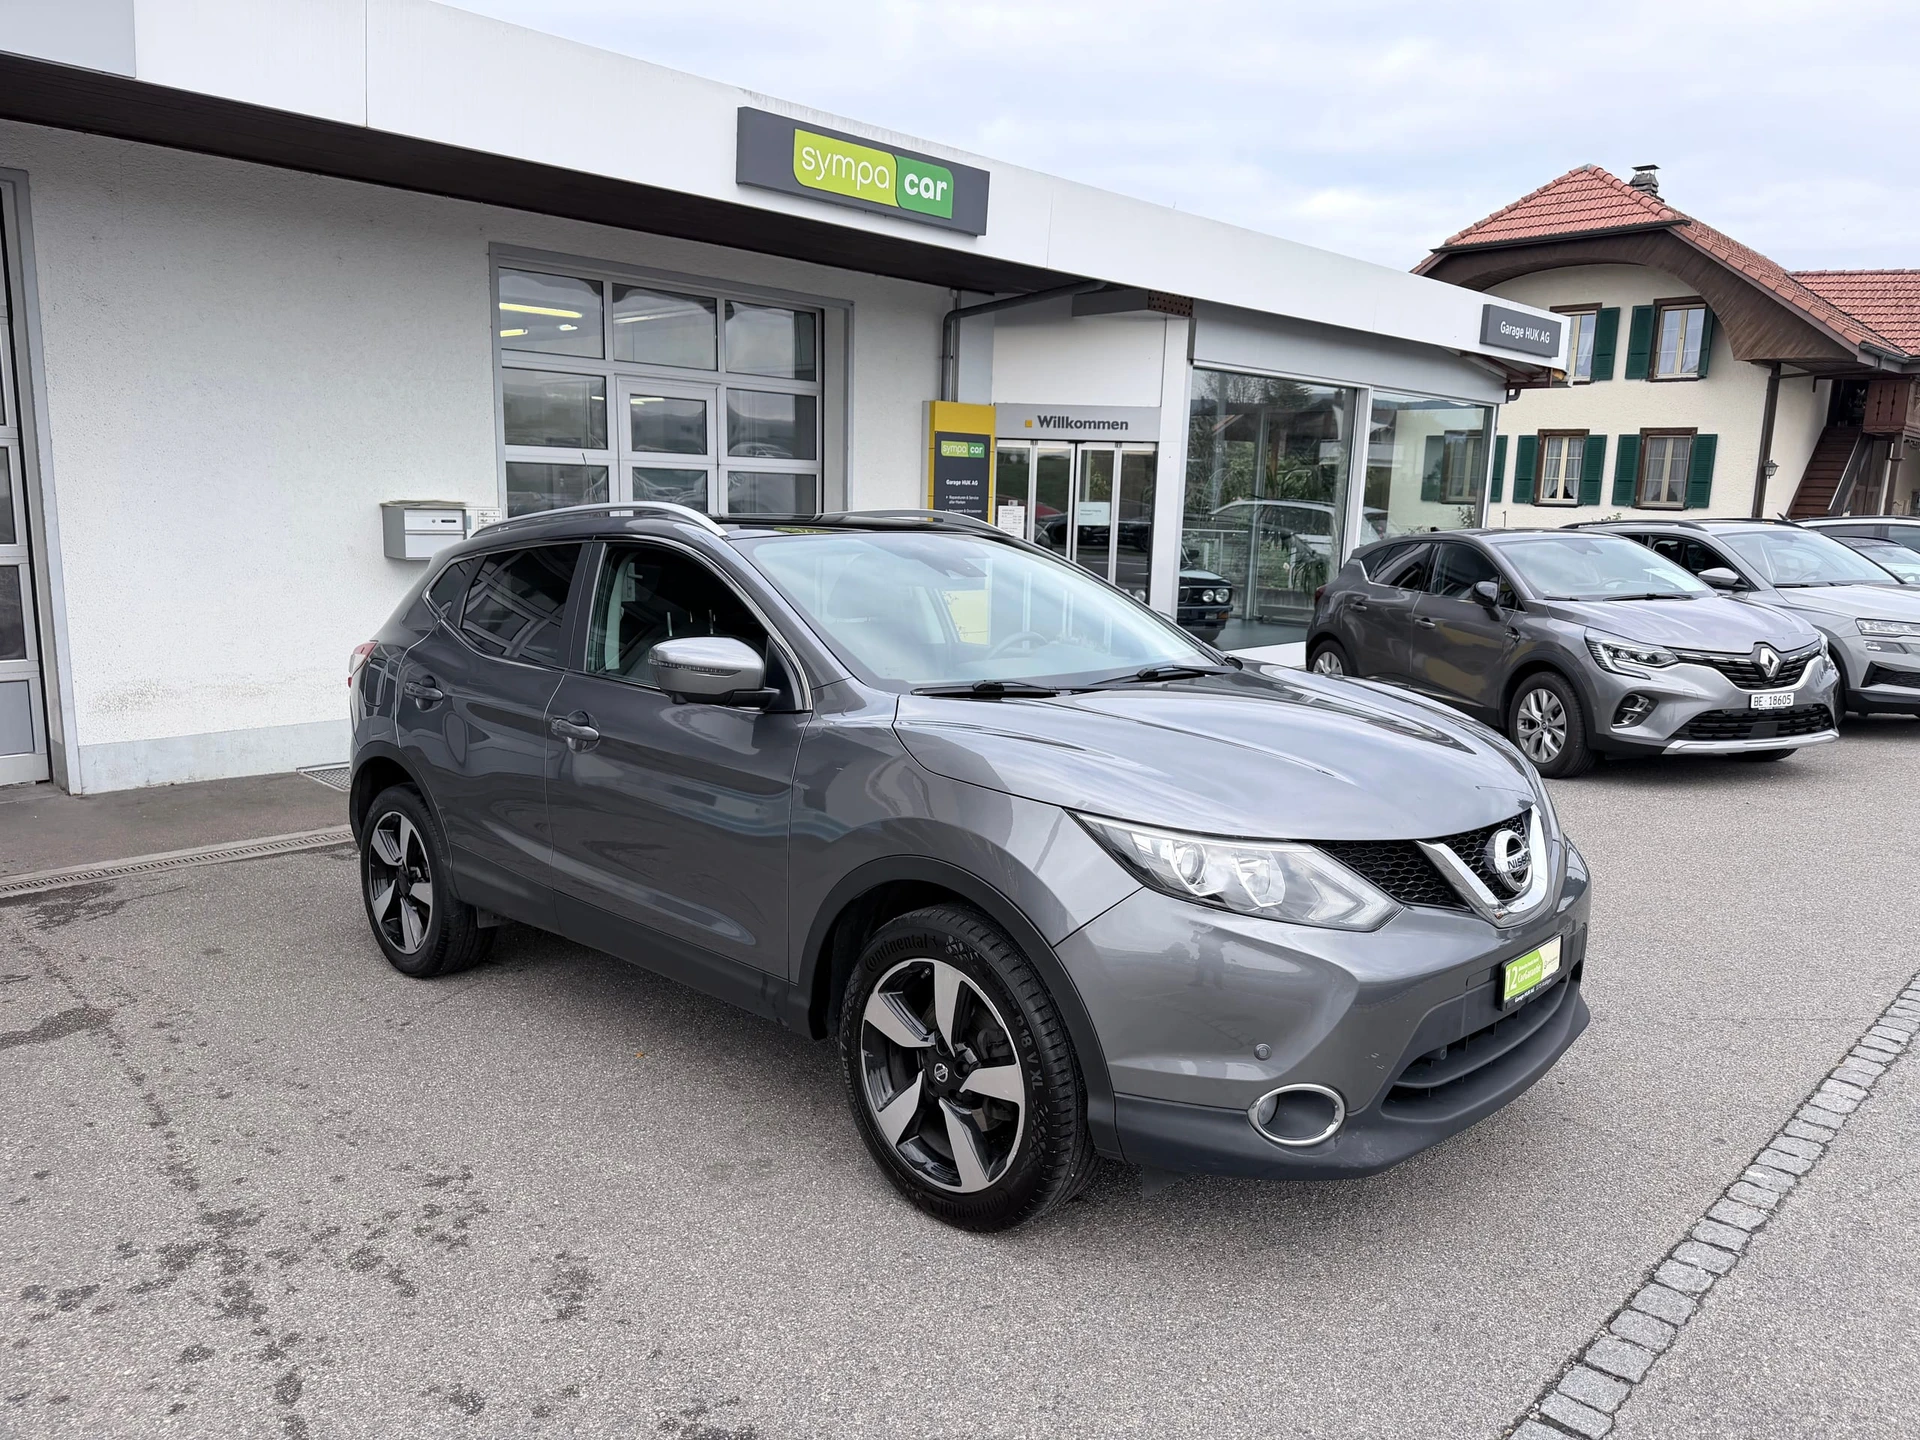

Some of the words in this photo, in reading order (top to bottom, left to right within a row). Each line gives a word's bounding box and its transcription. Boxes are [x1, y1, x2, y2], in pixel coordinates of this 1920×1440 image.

[801, 146, 889, 191] sympa
[904, 173, 948, 202] car
[1500, 320, 1525, 339] Garage
[1525, 327, 1540, 342] HUK
[1540, 330, 1550, 344] AG
[1037, 415, 1129, 431] Willkommen
[943, 444, 967, 455] sympa
[970, 446, 983, 454] car
[1753, 696, 1764, 707] BE
[1768, 694, 1792, 706] 18605
[864, 933, 929, 973] Continental
[1505, 965, 1519, 993] 12
[1029, 1068, 1044, 1090] XL
